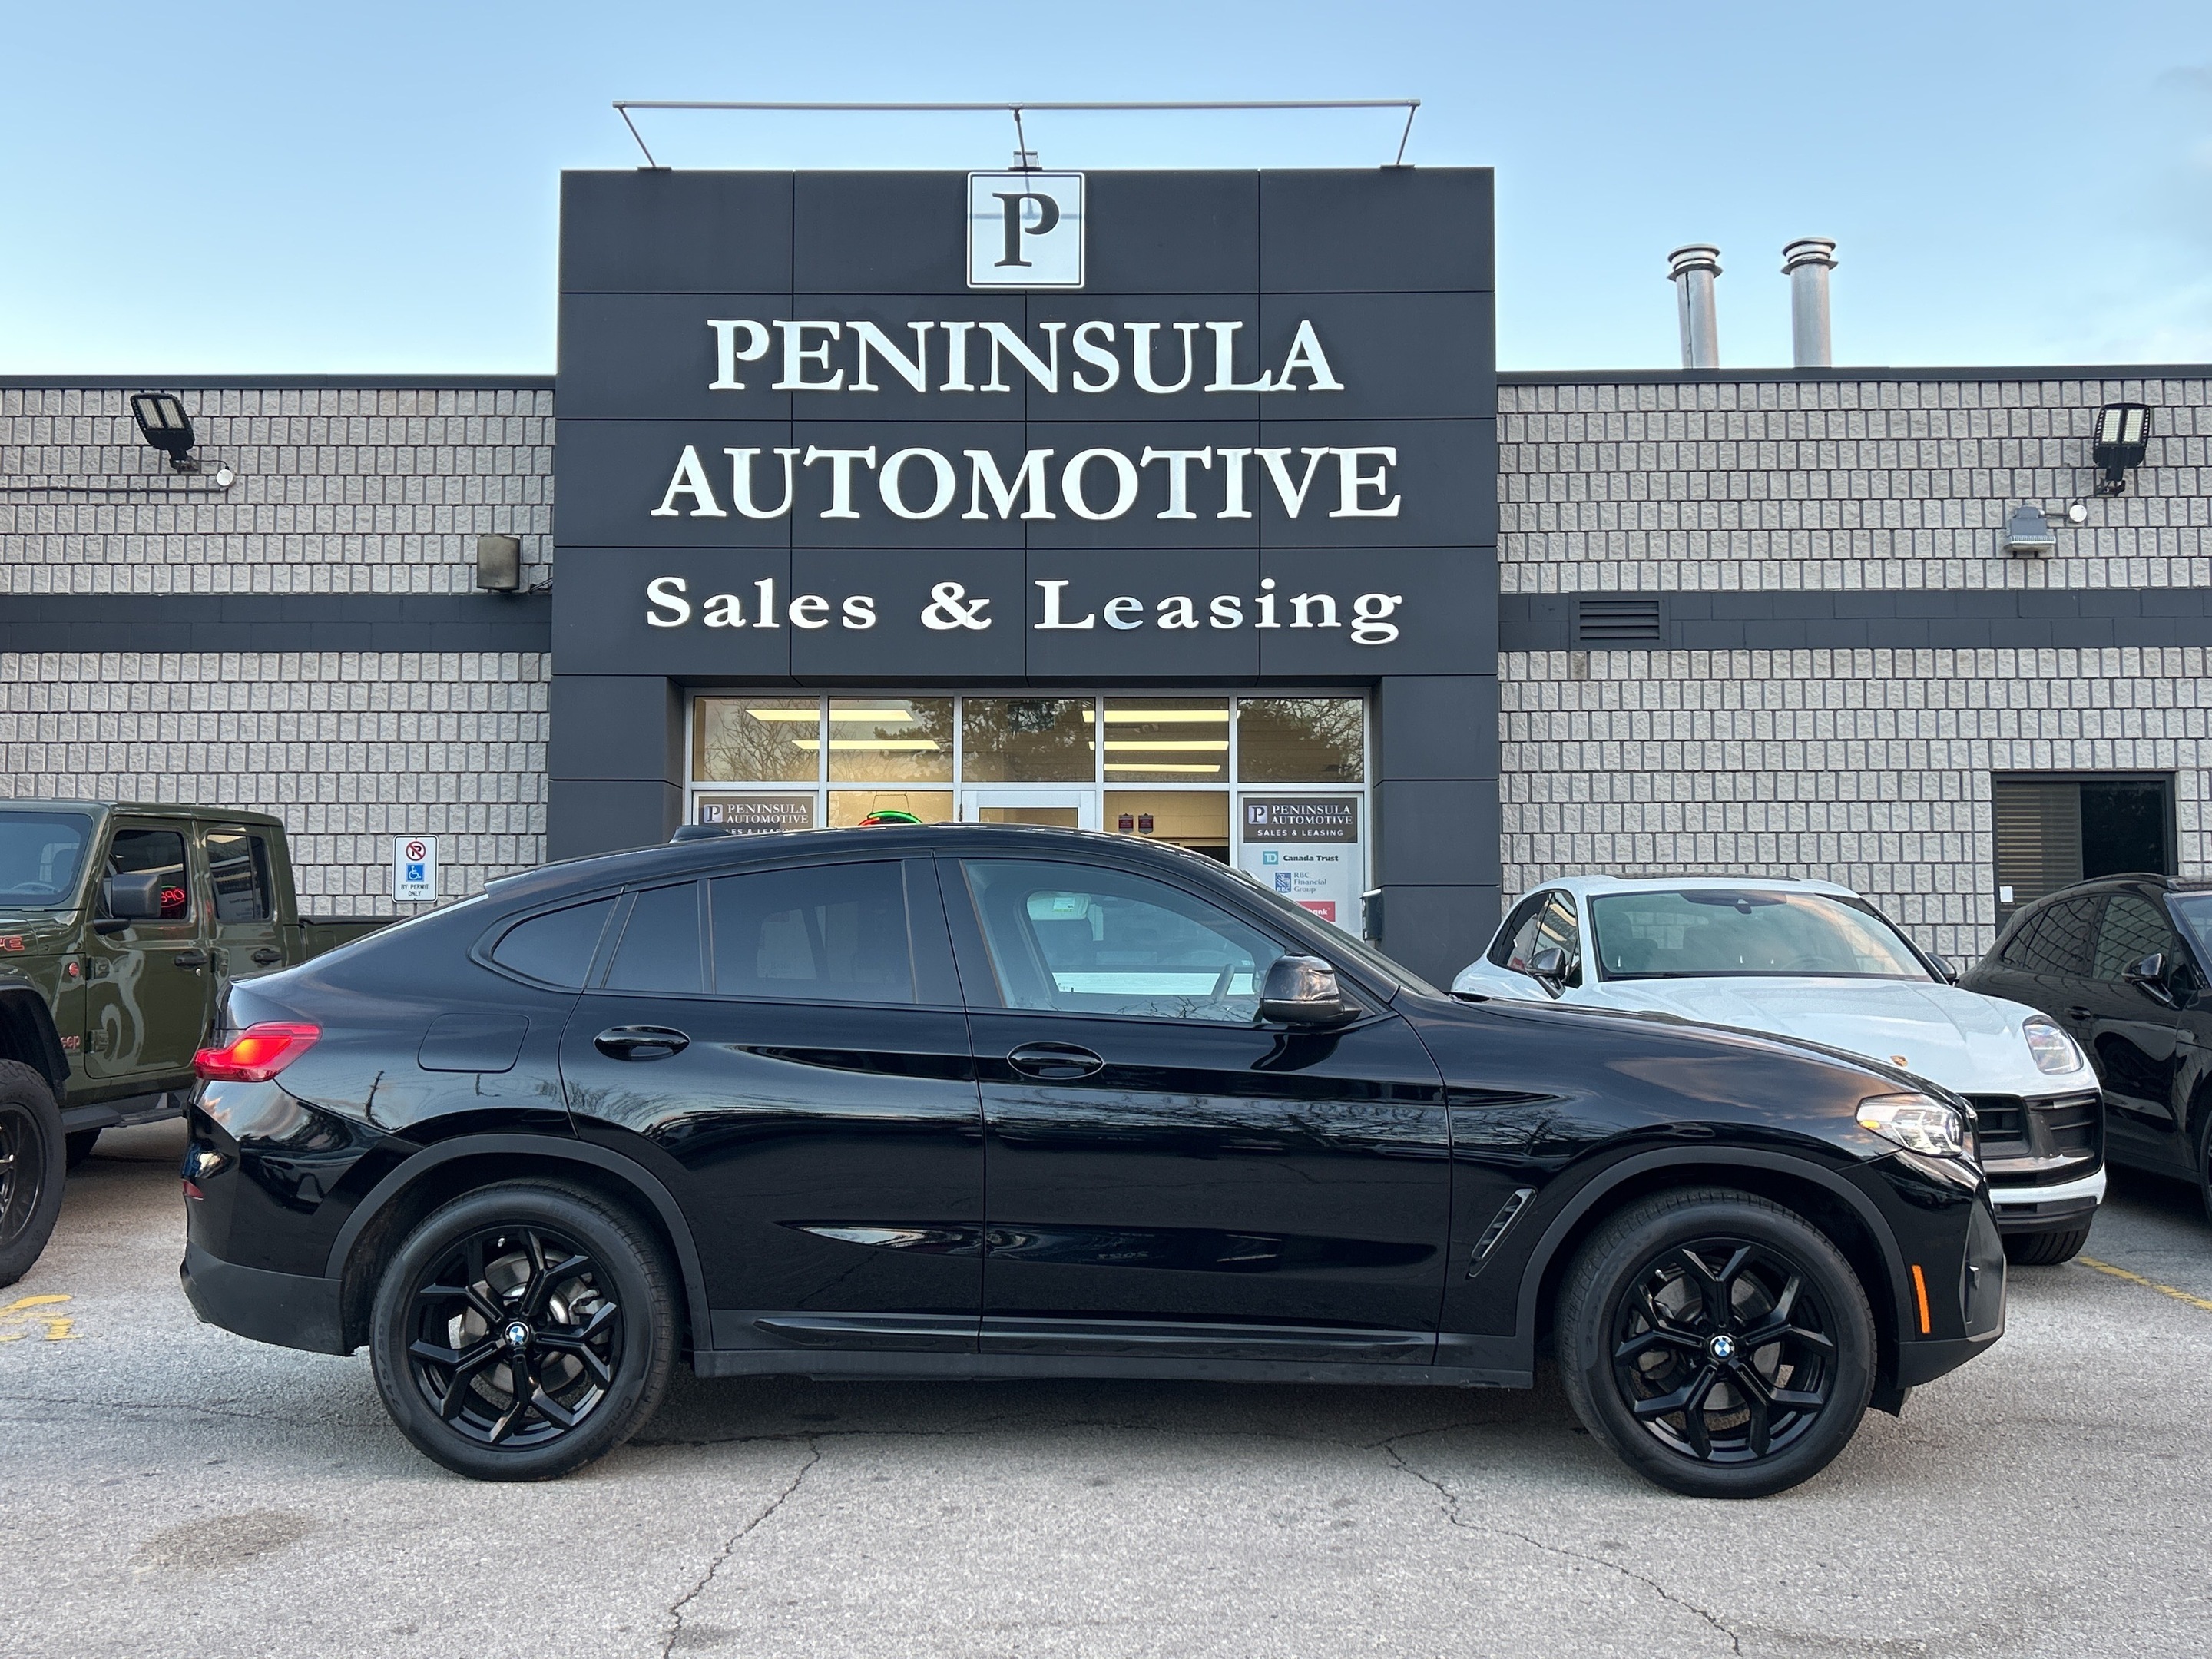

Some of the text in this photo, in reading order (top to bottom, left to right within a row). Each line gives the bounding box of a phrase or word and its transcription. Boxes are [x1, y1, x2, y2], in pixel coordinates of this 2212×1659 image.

[992, 192, 1058, 268] P
[707, 319, 1345, 393] PENINSULA
[651, 444, 1402, 521] AUTOMOTIVE
[645, 576, 1403, 646] Sales & Leasing
[707, 806, 720, 822] P
[727, 803, 807, 813] PENINSULA
[1252, 806, 1265, 823] P
[1271, 805, 1352, 814] PENINSULA
[727, 815, 809, 823] AUTOMOTIVE
[1271, 816, 1353, 825] AUTOMOTIVE
[1264, 853, 1277, 863] TD
[1293, 886, 1316, 894] Group
